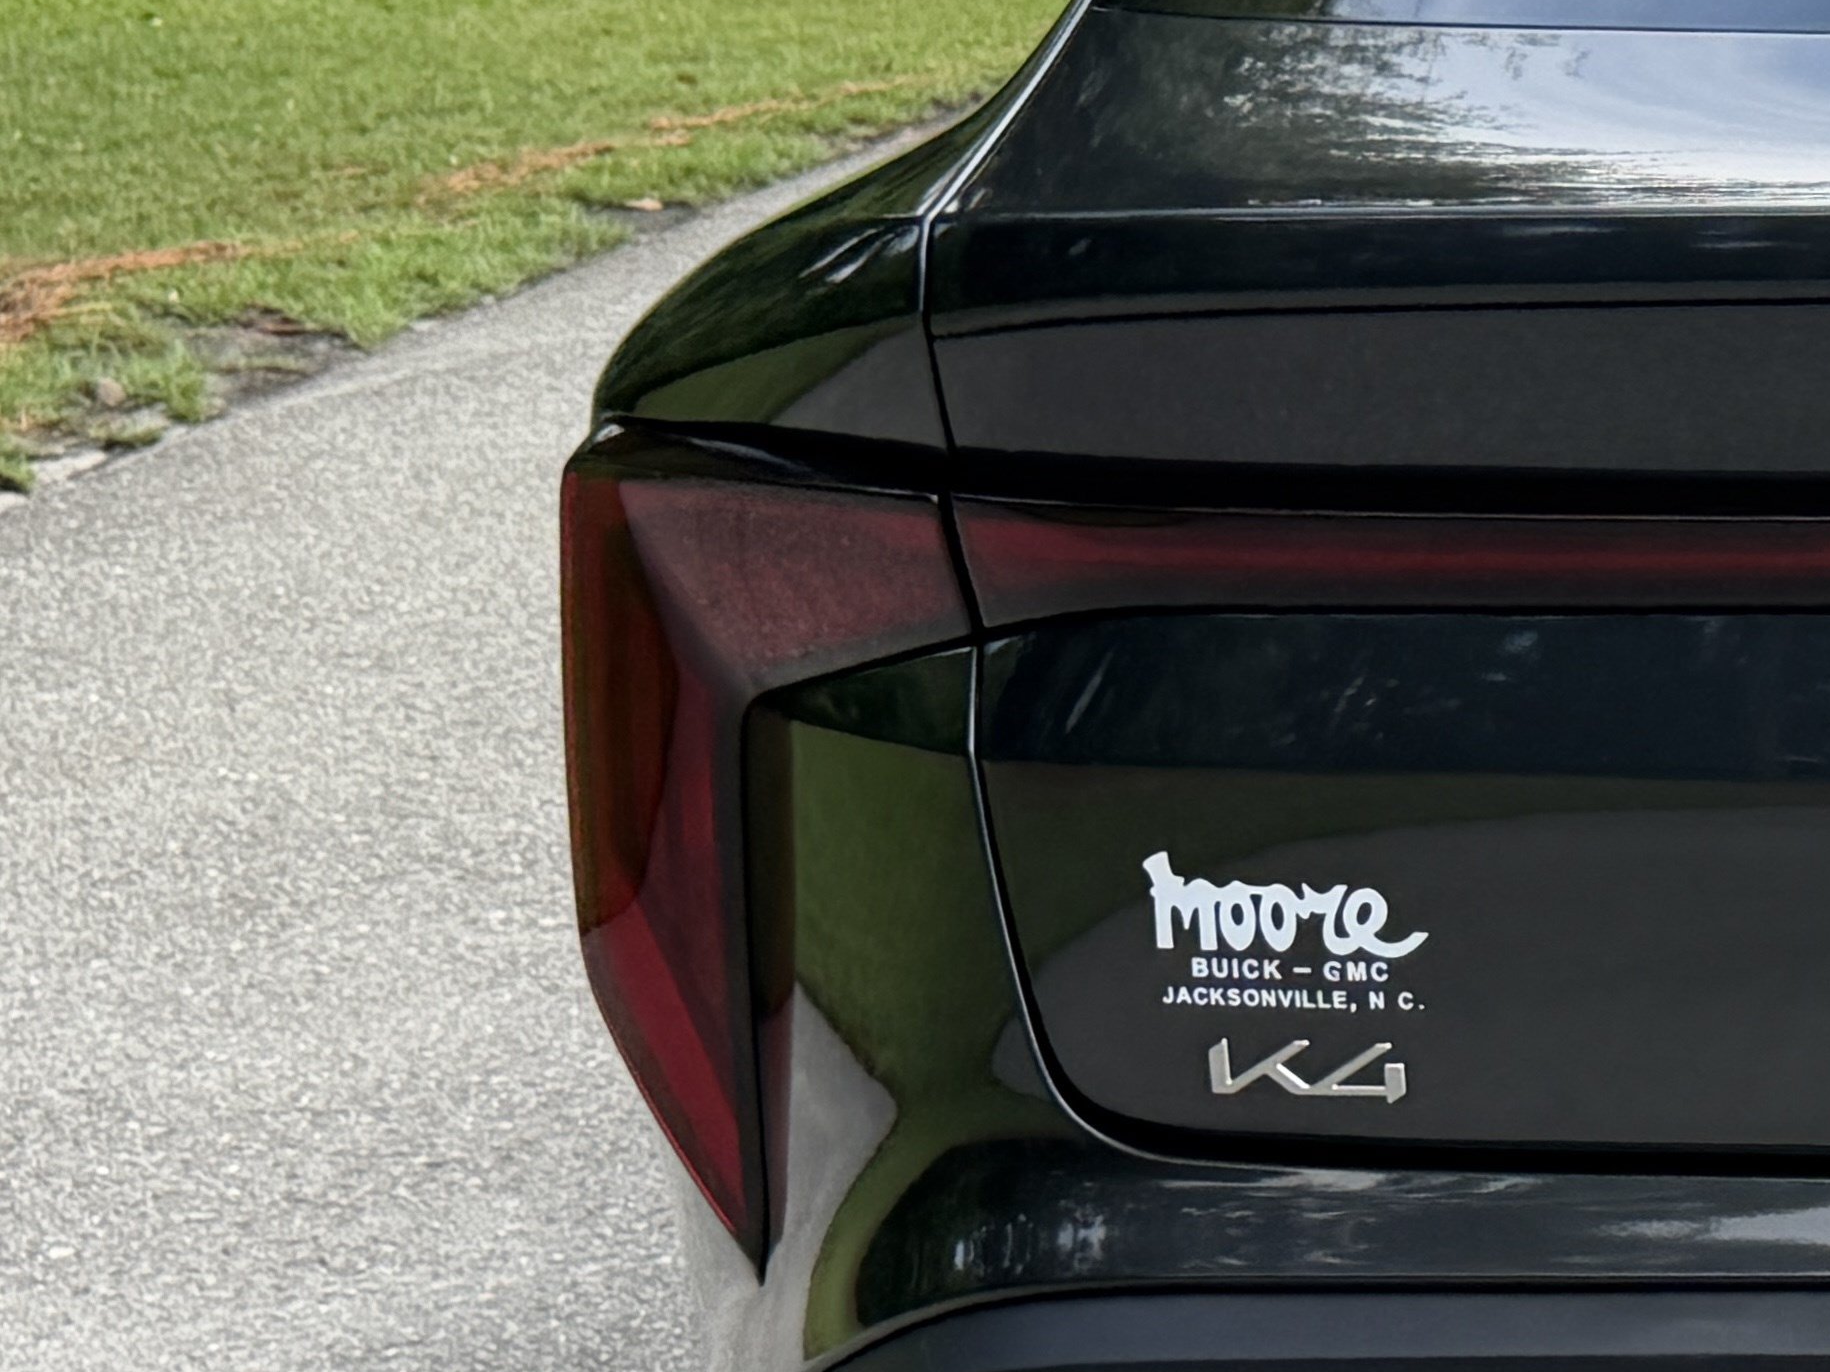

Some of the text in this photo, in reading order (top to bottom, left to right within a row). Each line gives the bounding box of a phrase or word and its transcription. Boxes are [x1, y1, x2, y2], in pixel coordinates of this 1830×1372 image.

[1190, 956, 1283, 981] BUICK
[1322, 960, 1390, 983] GMC
[1161, 985, 1358, 1014] JACKSONVILLE,
[1207, 1036, 1407, 1105] K4
